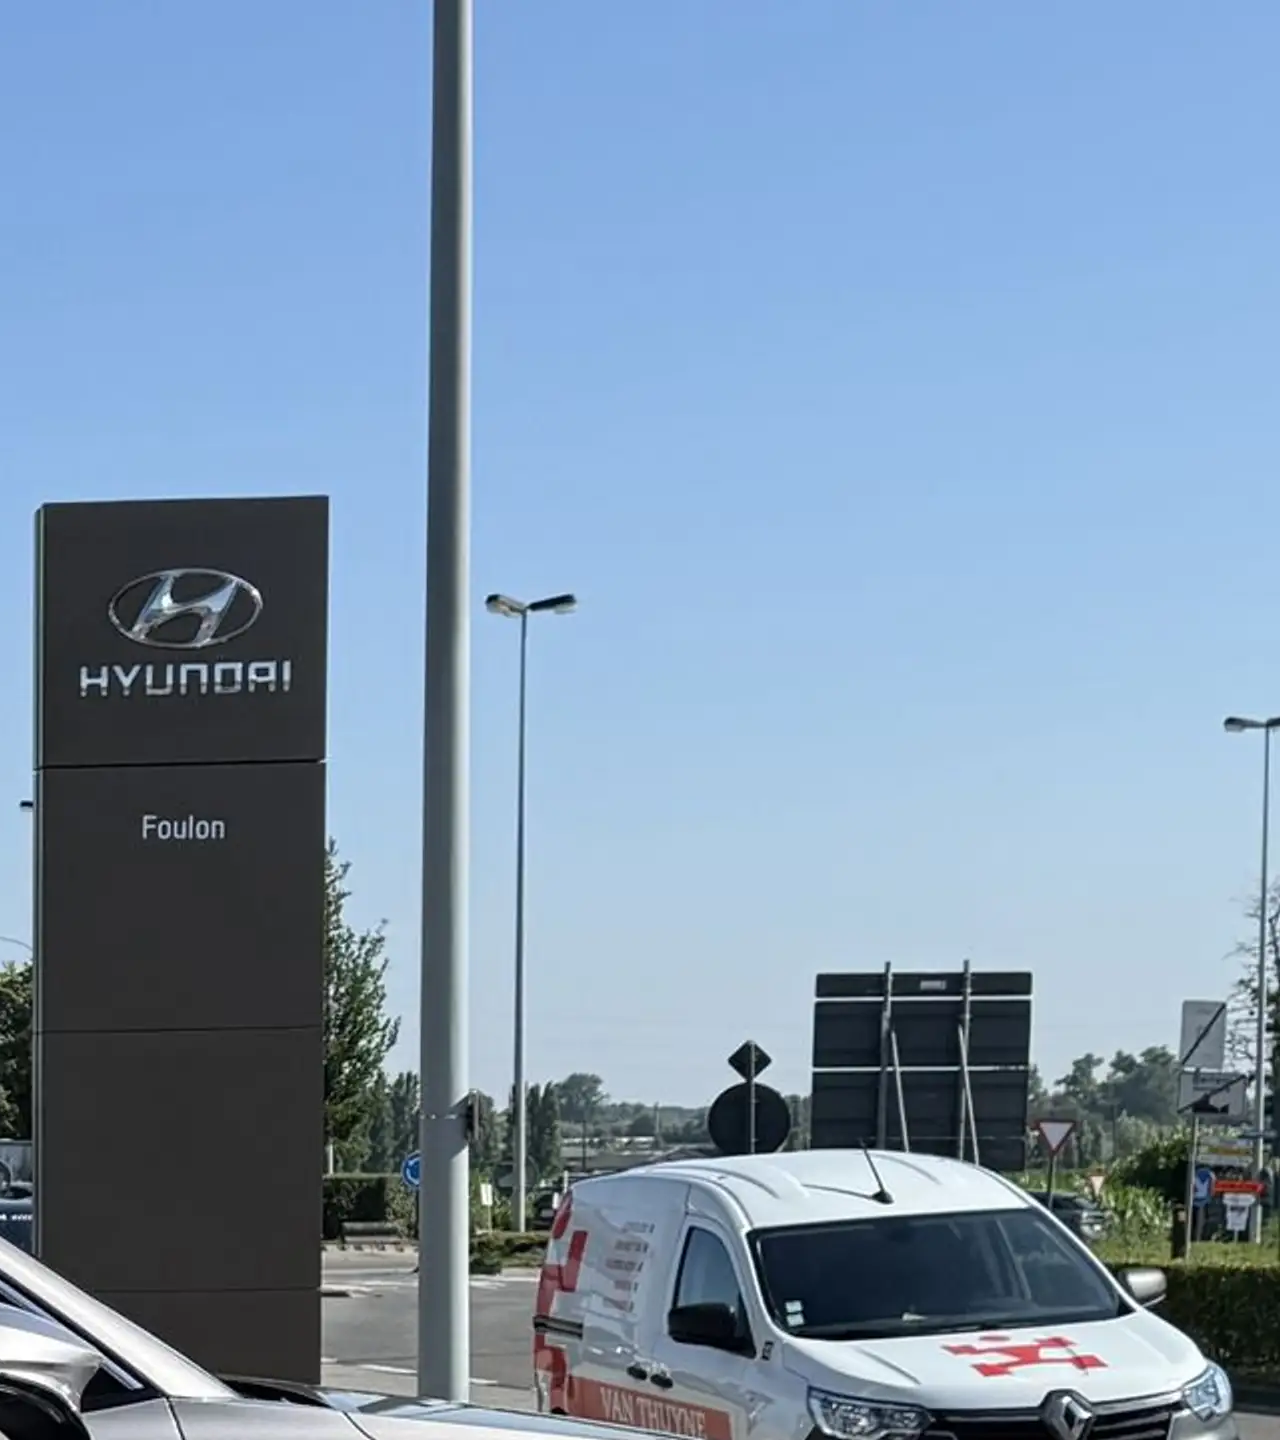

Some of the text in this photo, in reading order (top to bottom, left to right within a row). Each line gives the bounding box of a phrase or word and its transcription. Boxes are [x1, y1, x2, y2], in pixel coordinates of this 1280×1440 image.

[79, 660, 292, 697] HYUNDAI
[141, 814, 226, 840] Foulon
[599, 1386, 634, 1424] VAN
